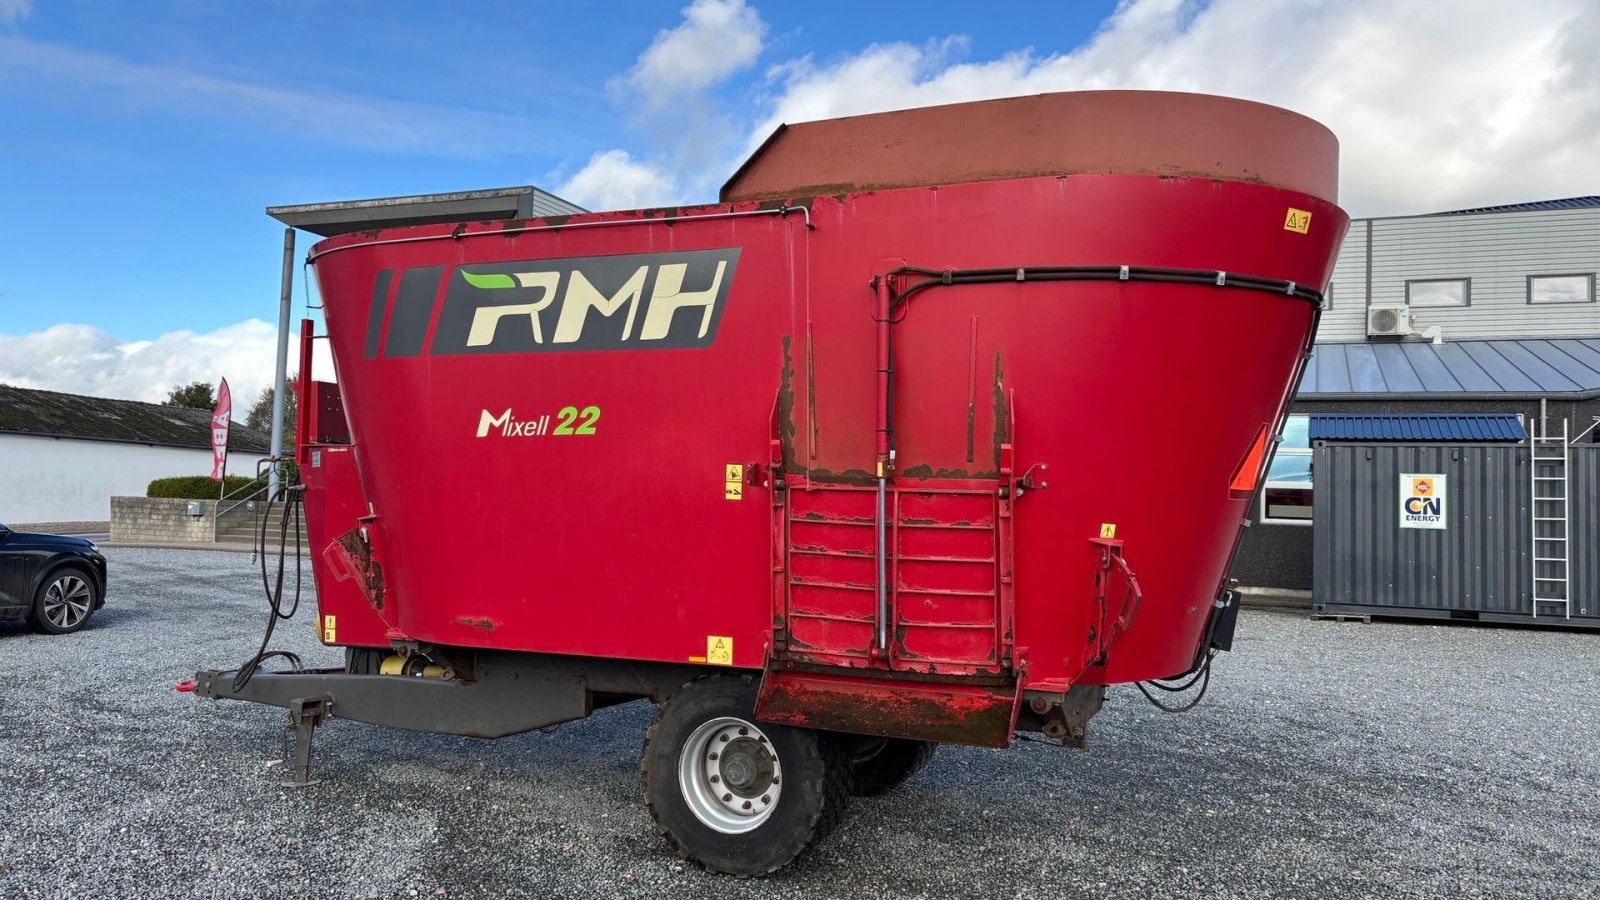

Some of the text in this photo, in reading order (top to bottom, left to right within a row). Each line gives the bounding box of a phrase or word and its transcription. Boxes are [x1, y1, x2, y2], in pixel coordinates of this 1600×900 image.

[461, 261, 727, 347] RMH
[476, 406, 601, 438] Mixell 22
[1404, 497, 1441, 515] CN
